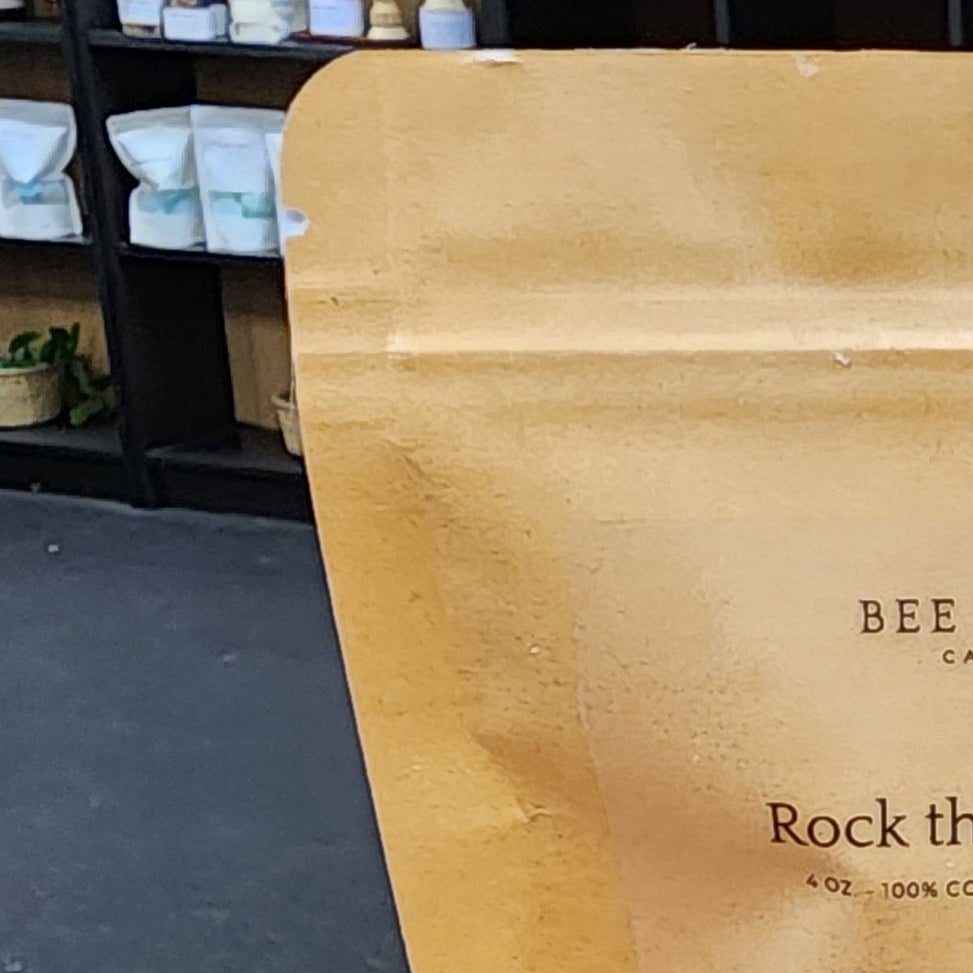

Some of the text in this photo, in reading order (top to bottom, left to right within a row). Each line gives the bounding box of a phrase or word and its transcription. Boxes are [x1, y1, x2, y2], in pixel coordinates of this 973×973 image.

[859, 599, 956, 634] BEE
[766, 798, 909, 848] Rock
[806, 874, 818, 888] 4
[882, 881, 938, 899] 100%
